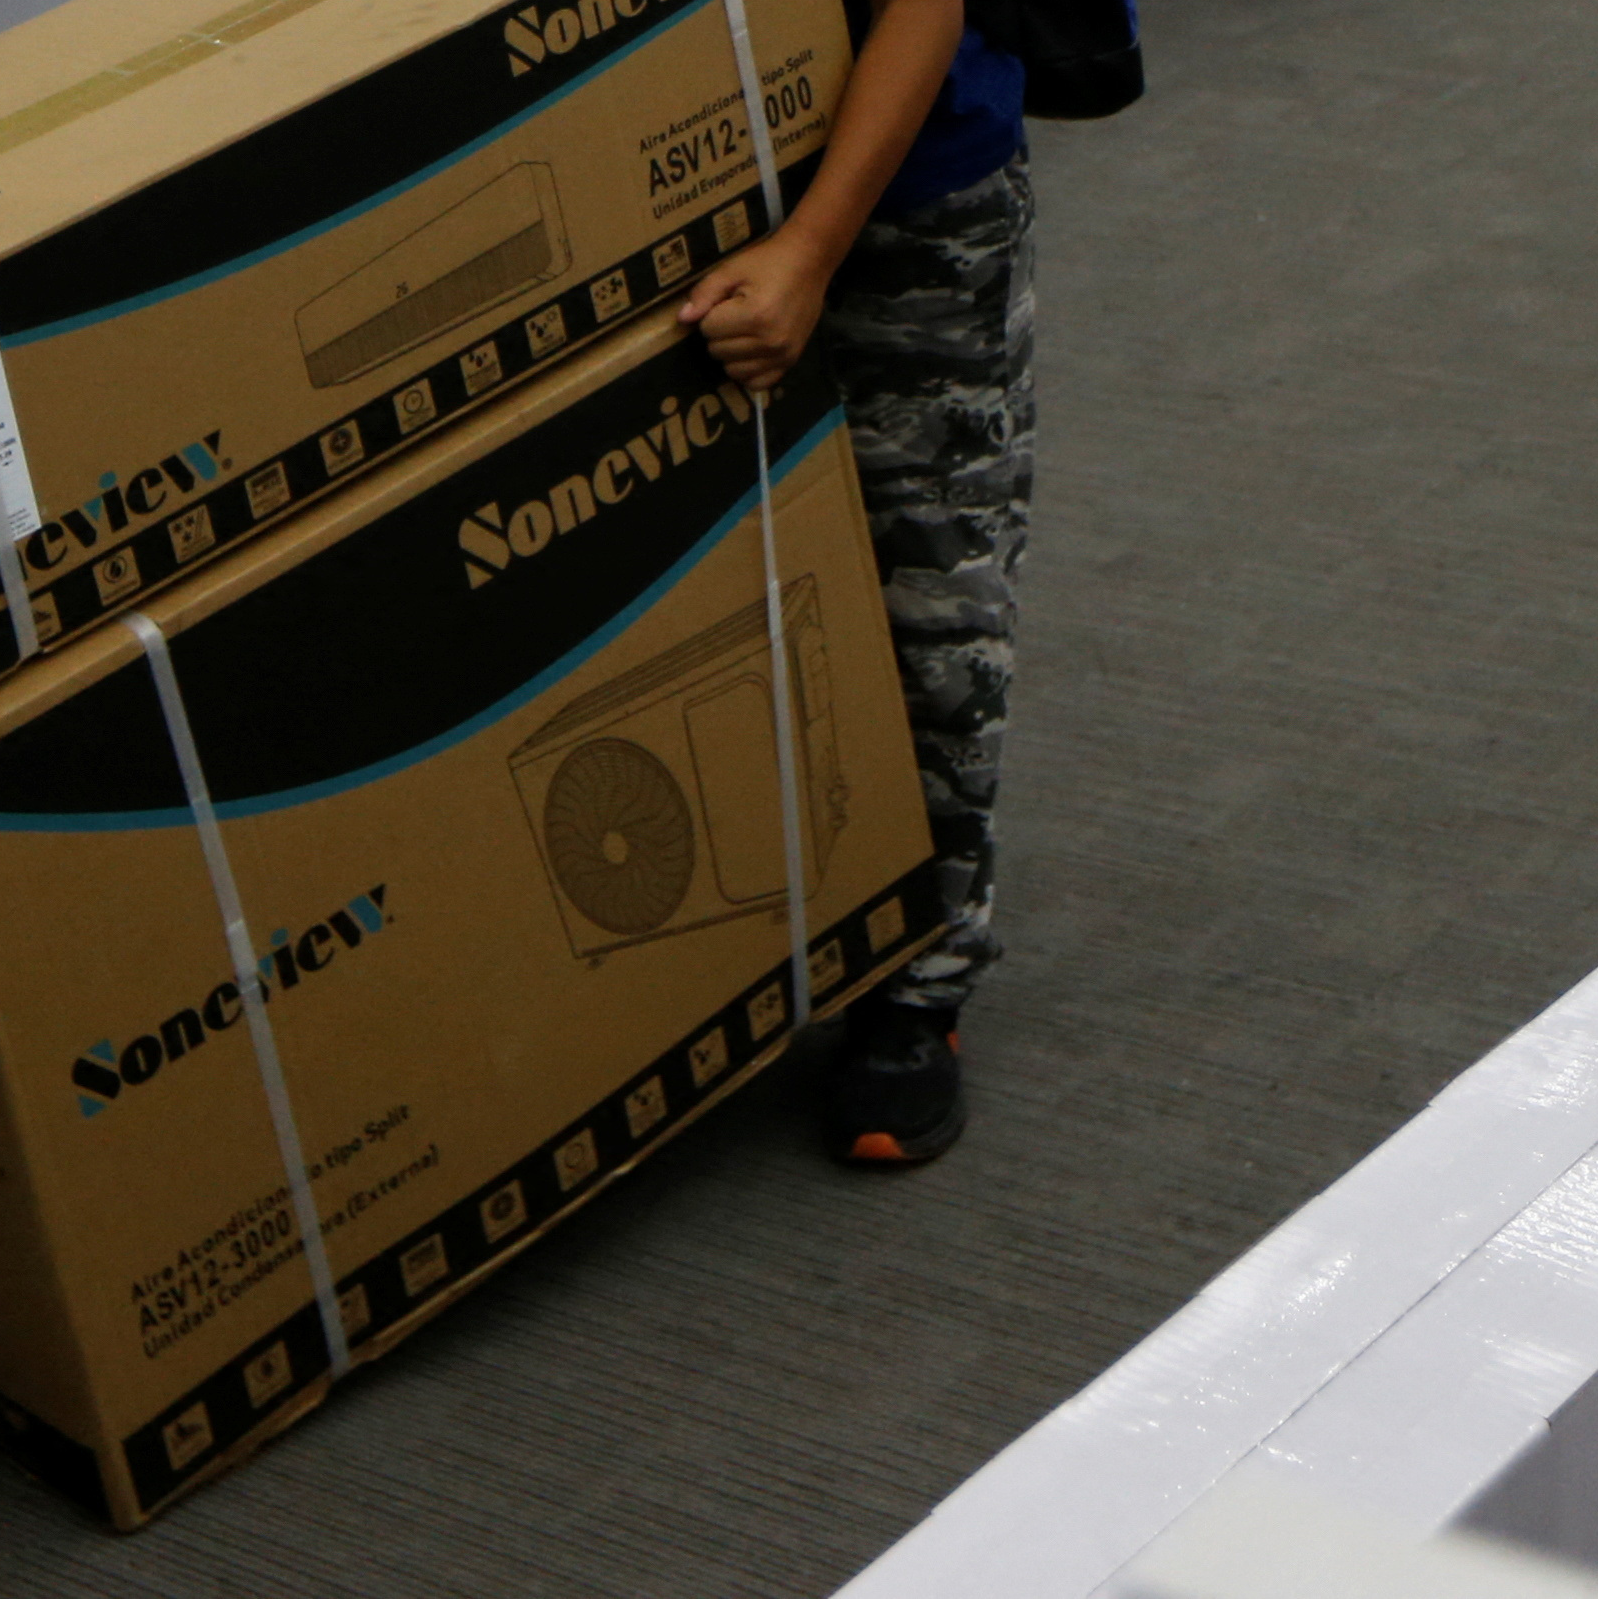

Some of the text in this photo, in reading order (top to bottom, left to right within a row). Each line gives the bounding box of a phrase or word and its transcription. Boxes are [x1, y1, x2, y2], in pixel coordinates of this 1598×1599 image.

[760, 66, 785, 87] tipo
[785, 49, 814, 74] Split
[648, 74, 813, 198] ASV12-000
[652, 183, 699, 220] Unidad
[324, 1137, 363, 1170] tipo
[364, 1104, 409, 1144] Split
[139, 1209, 291, 1334] ASV12-3000
